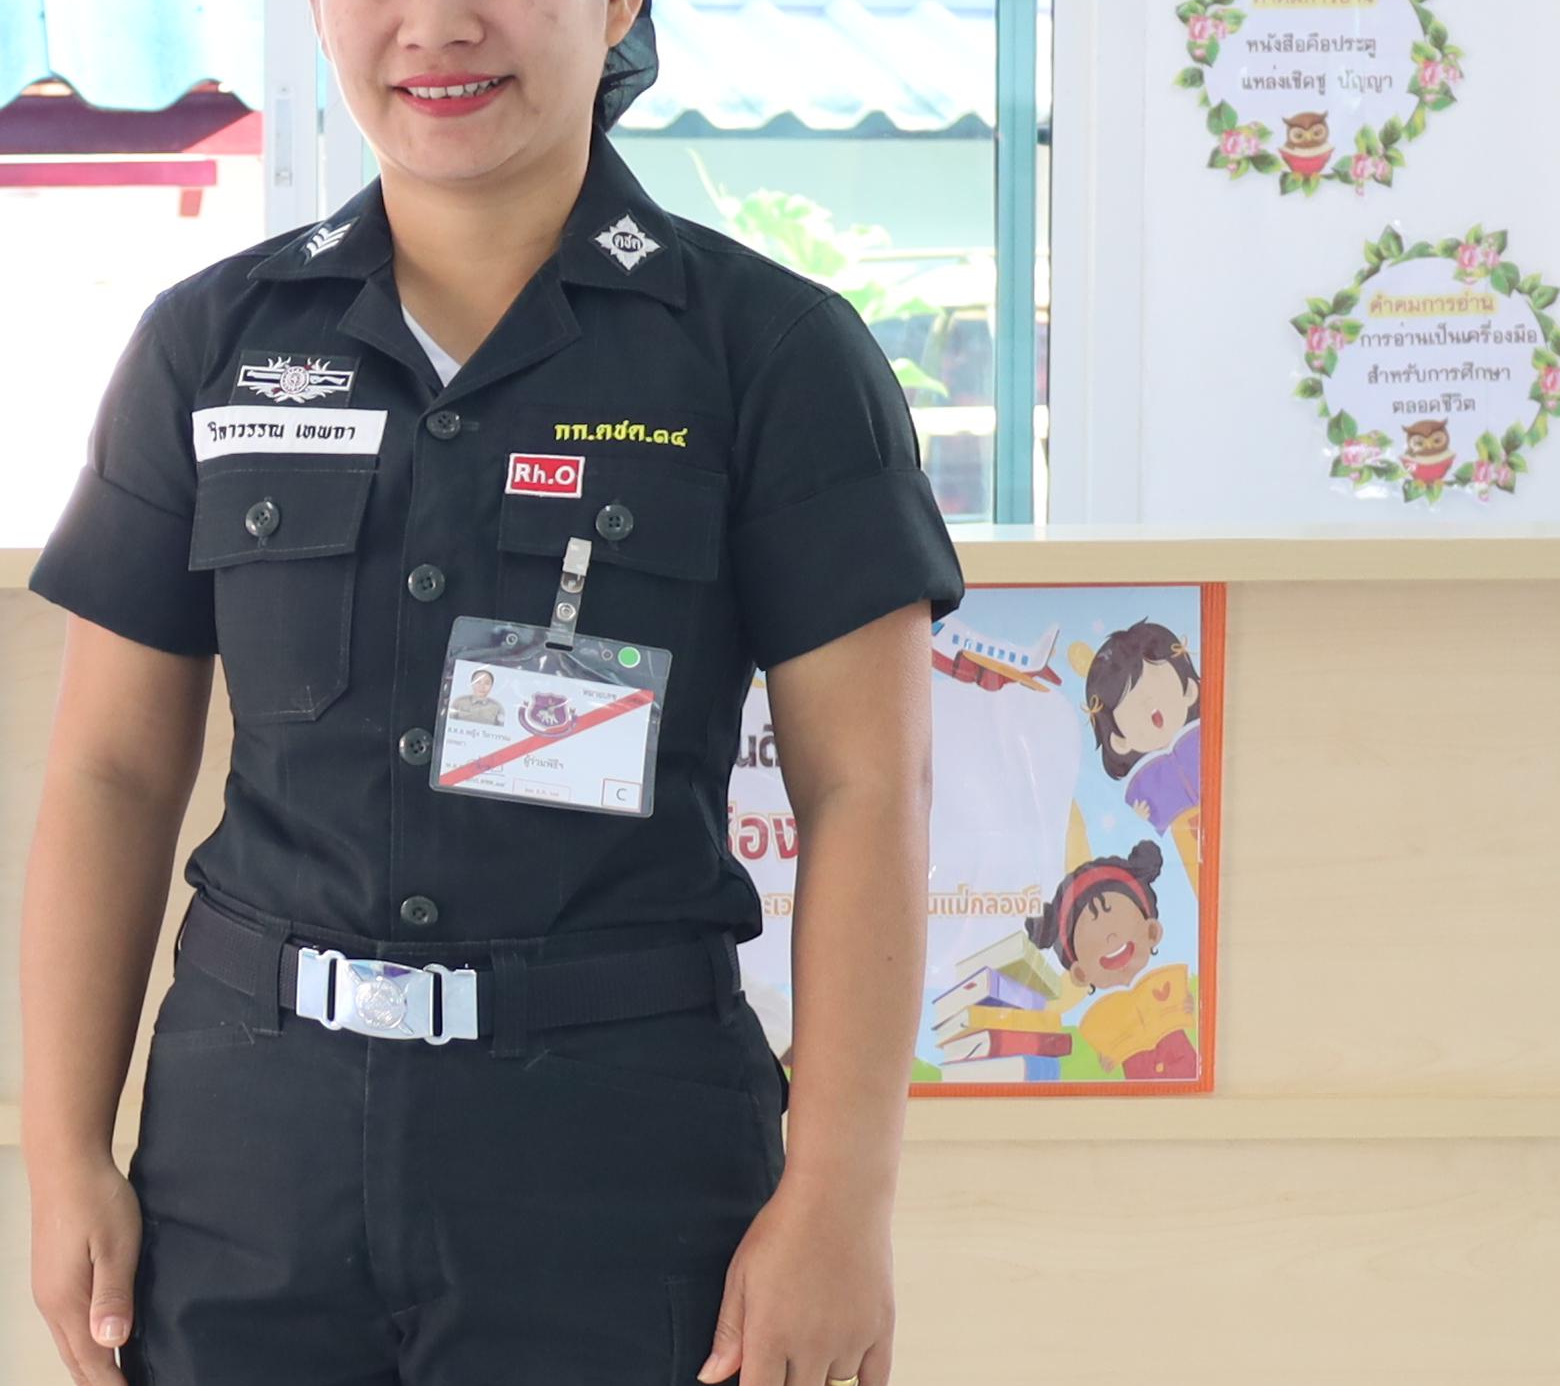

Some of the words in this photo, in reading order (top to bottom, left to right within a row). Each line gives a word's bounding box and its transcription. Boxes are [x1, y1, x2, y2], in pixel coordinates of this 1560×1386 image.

[1247, 32, 1376, 58] หนังสือคือประตู
[1242, 65, 1326, 95] แหล่งเชิดชู
[1338, 70, 1393, 94] ปัญญา
[1370, 293, 1494, 314] คำคมการอ่าน
[1361, 320, 1537, 348] การอ่านเป็นเครื่องมือ
[1368, 362, 1511, 384] สำหรับการศึกษา
[1392, 394, 1476, 414] ตลอดชีวิต
[514, 463, 576, 485] Rh.O
[616, 788, 627, 801] C
